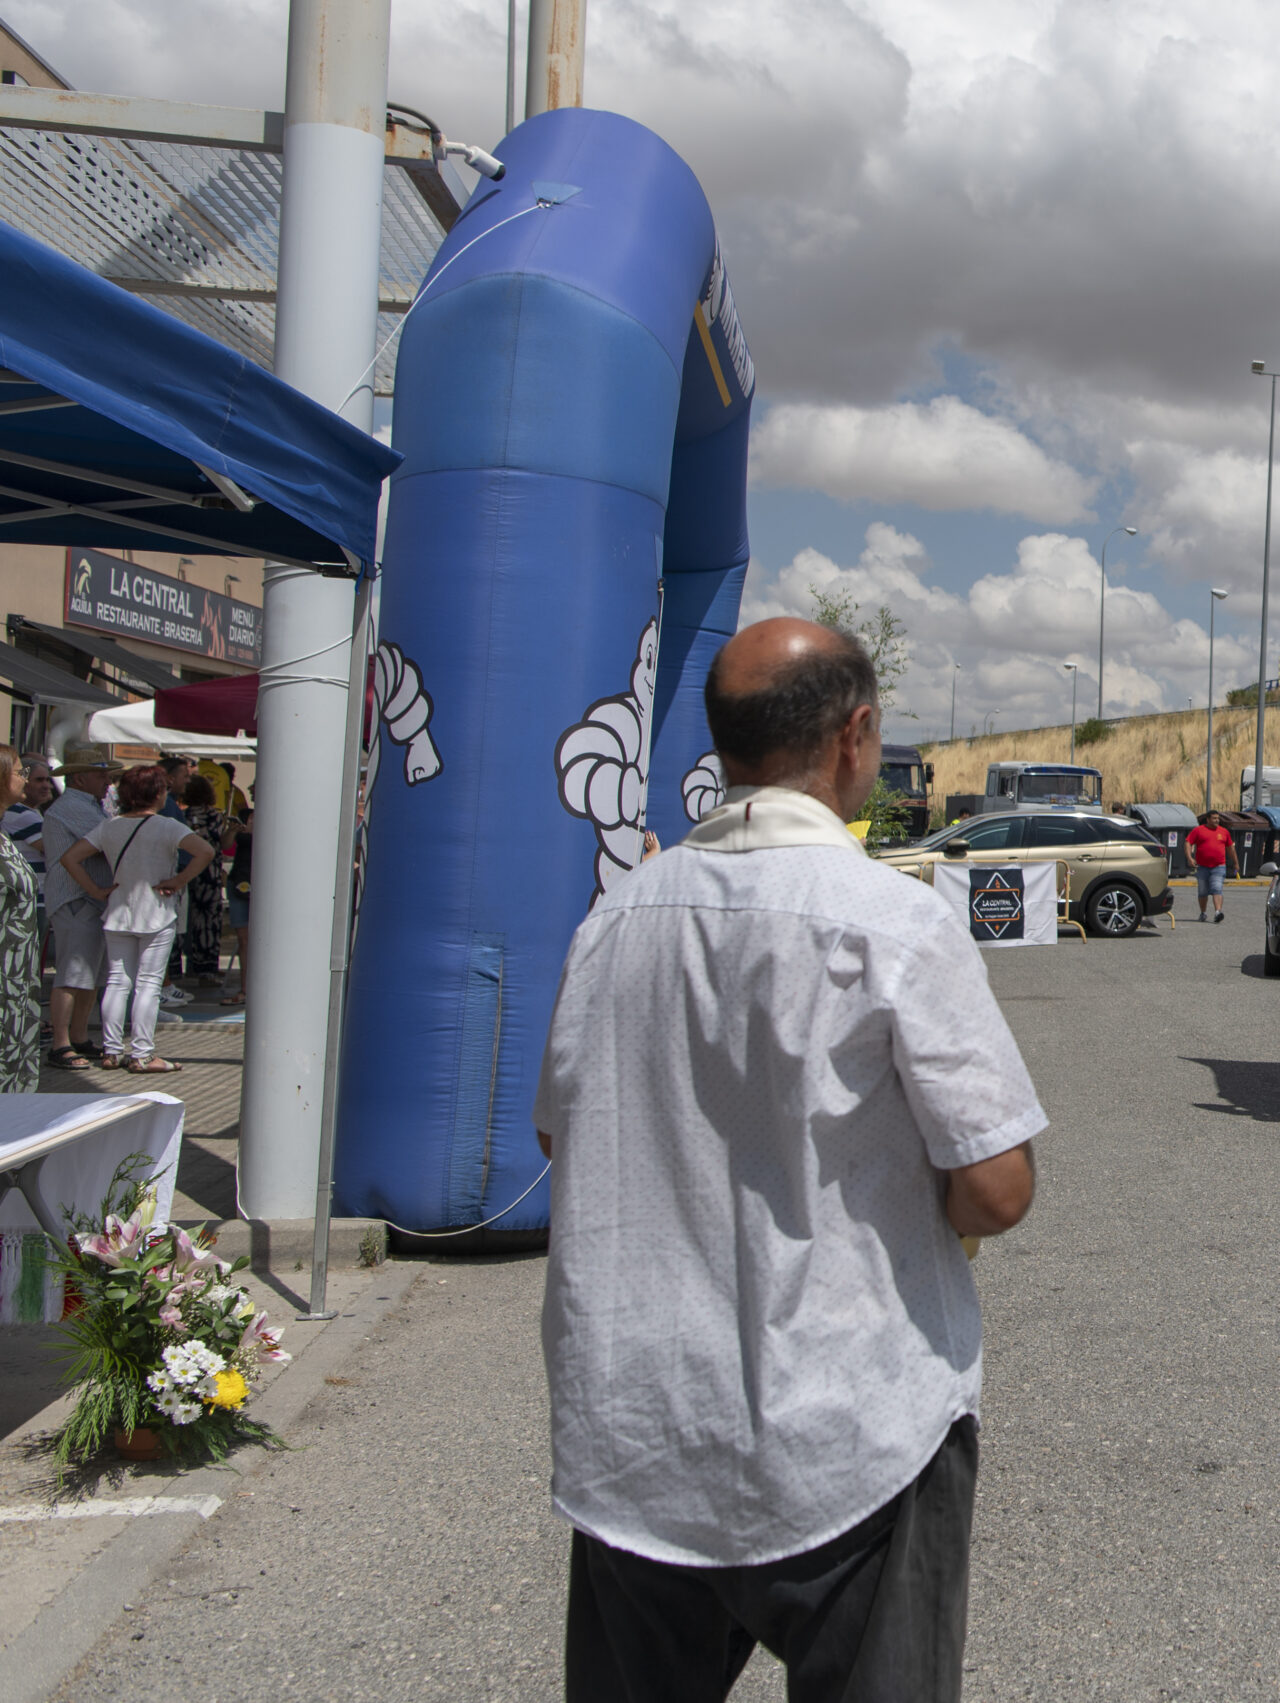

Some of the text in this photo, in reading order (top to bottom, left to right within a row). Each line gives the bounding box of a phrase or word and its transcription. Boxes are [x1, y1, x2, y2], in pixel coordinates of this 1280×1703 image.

[110, 567, 195, 619] LA CENTRAL
[229, 625, 255, 647] DIARIO
